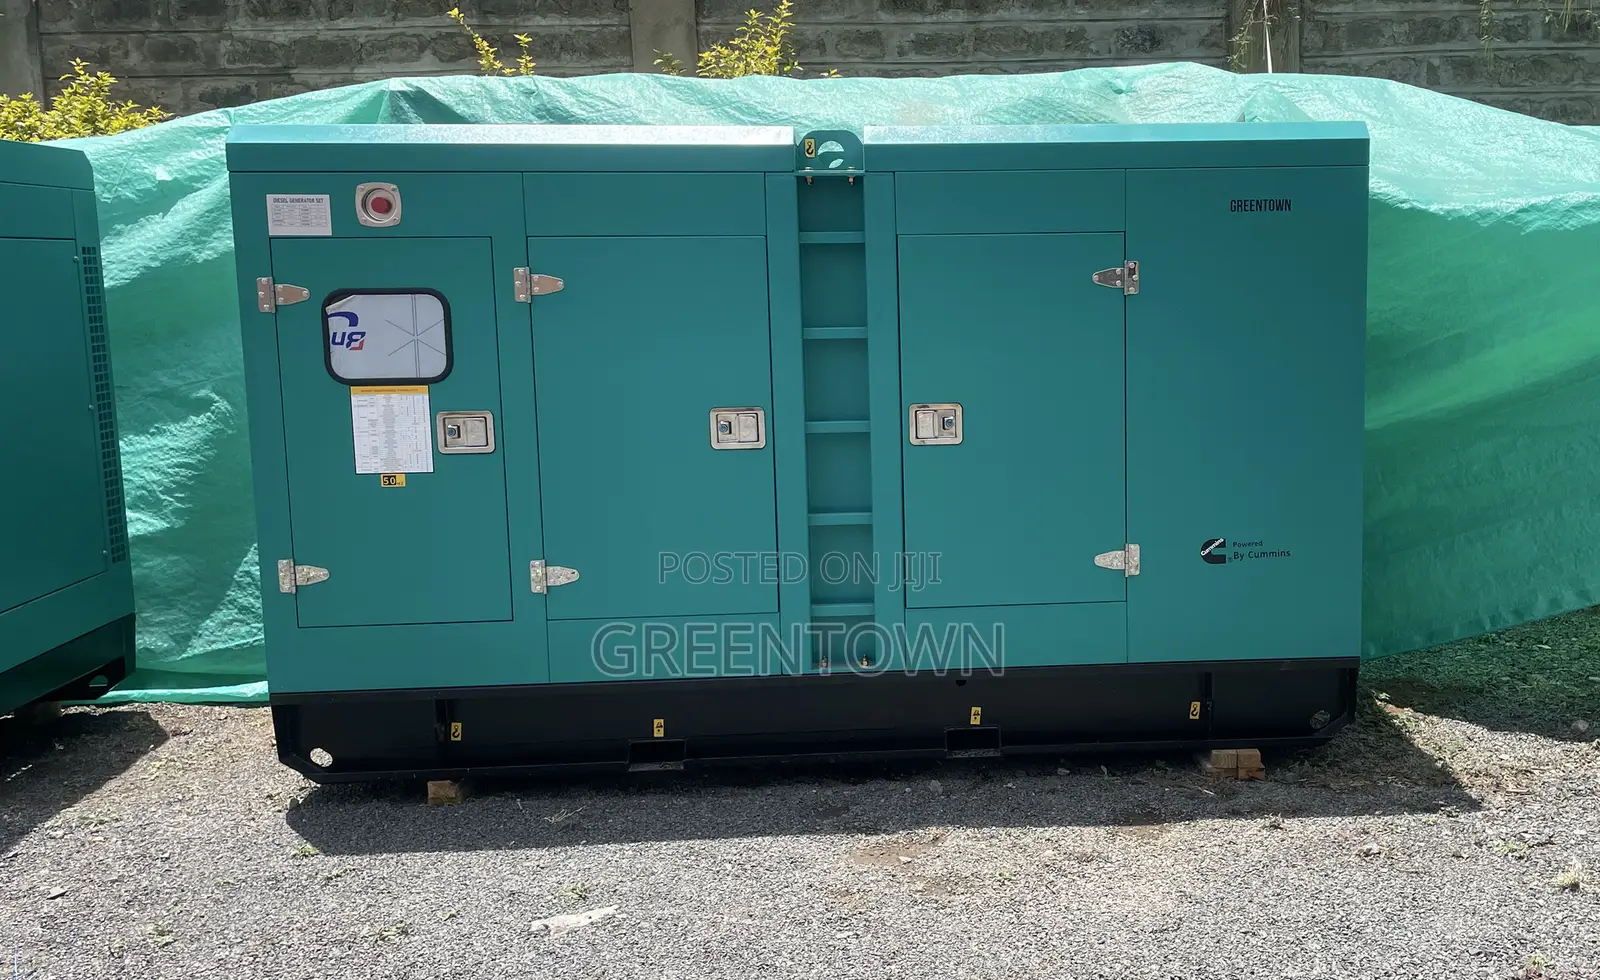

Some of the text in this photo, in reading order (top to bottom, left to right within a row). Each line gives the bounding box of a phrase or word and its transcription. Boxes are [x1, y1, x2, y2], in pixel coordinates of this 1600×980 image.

[1230, 199, 1291, 212] GREENTOWN
[383, 477, 396, 485] 50
[1232, 540, 1263, 548] Powered
[1233, 549, 1291, 562] By Cummins
